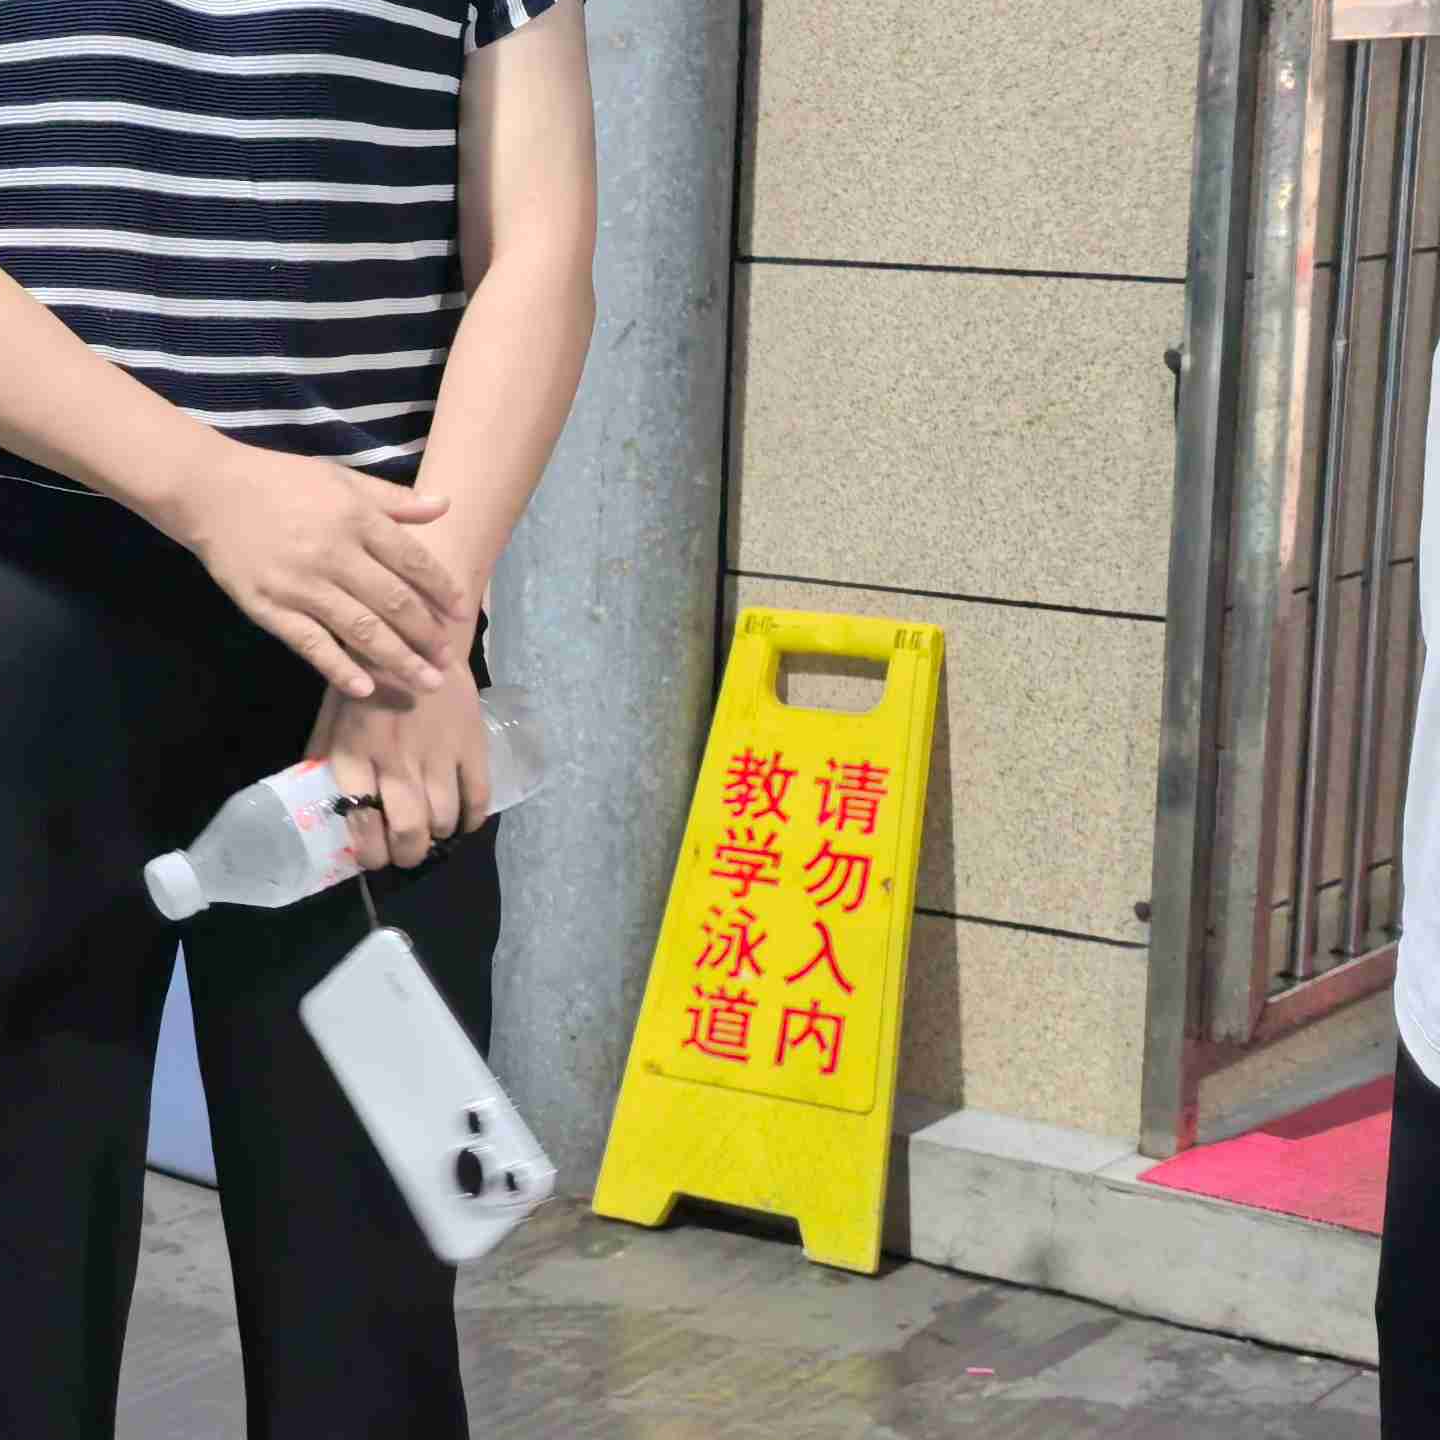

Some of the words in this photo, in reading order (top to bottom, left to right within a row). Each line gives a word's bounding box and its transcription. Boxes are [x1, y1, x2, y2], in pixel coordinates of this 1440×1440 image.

[681, 746, 799, 1065] 教学泳道
[773, 757, 892, 1077] 请勿入内
